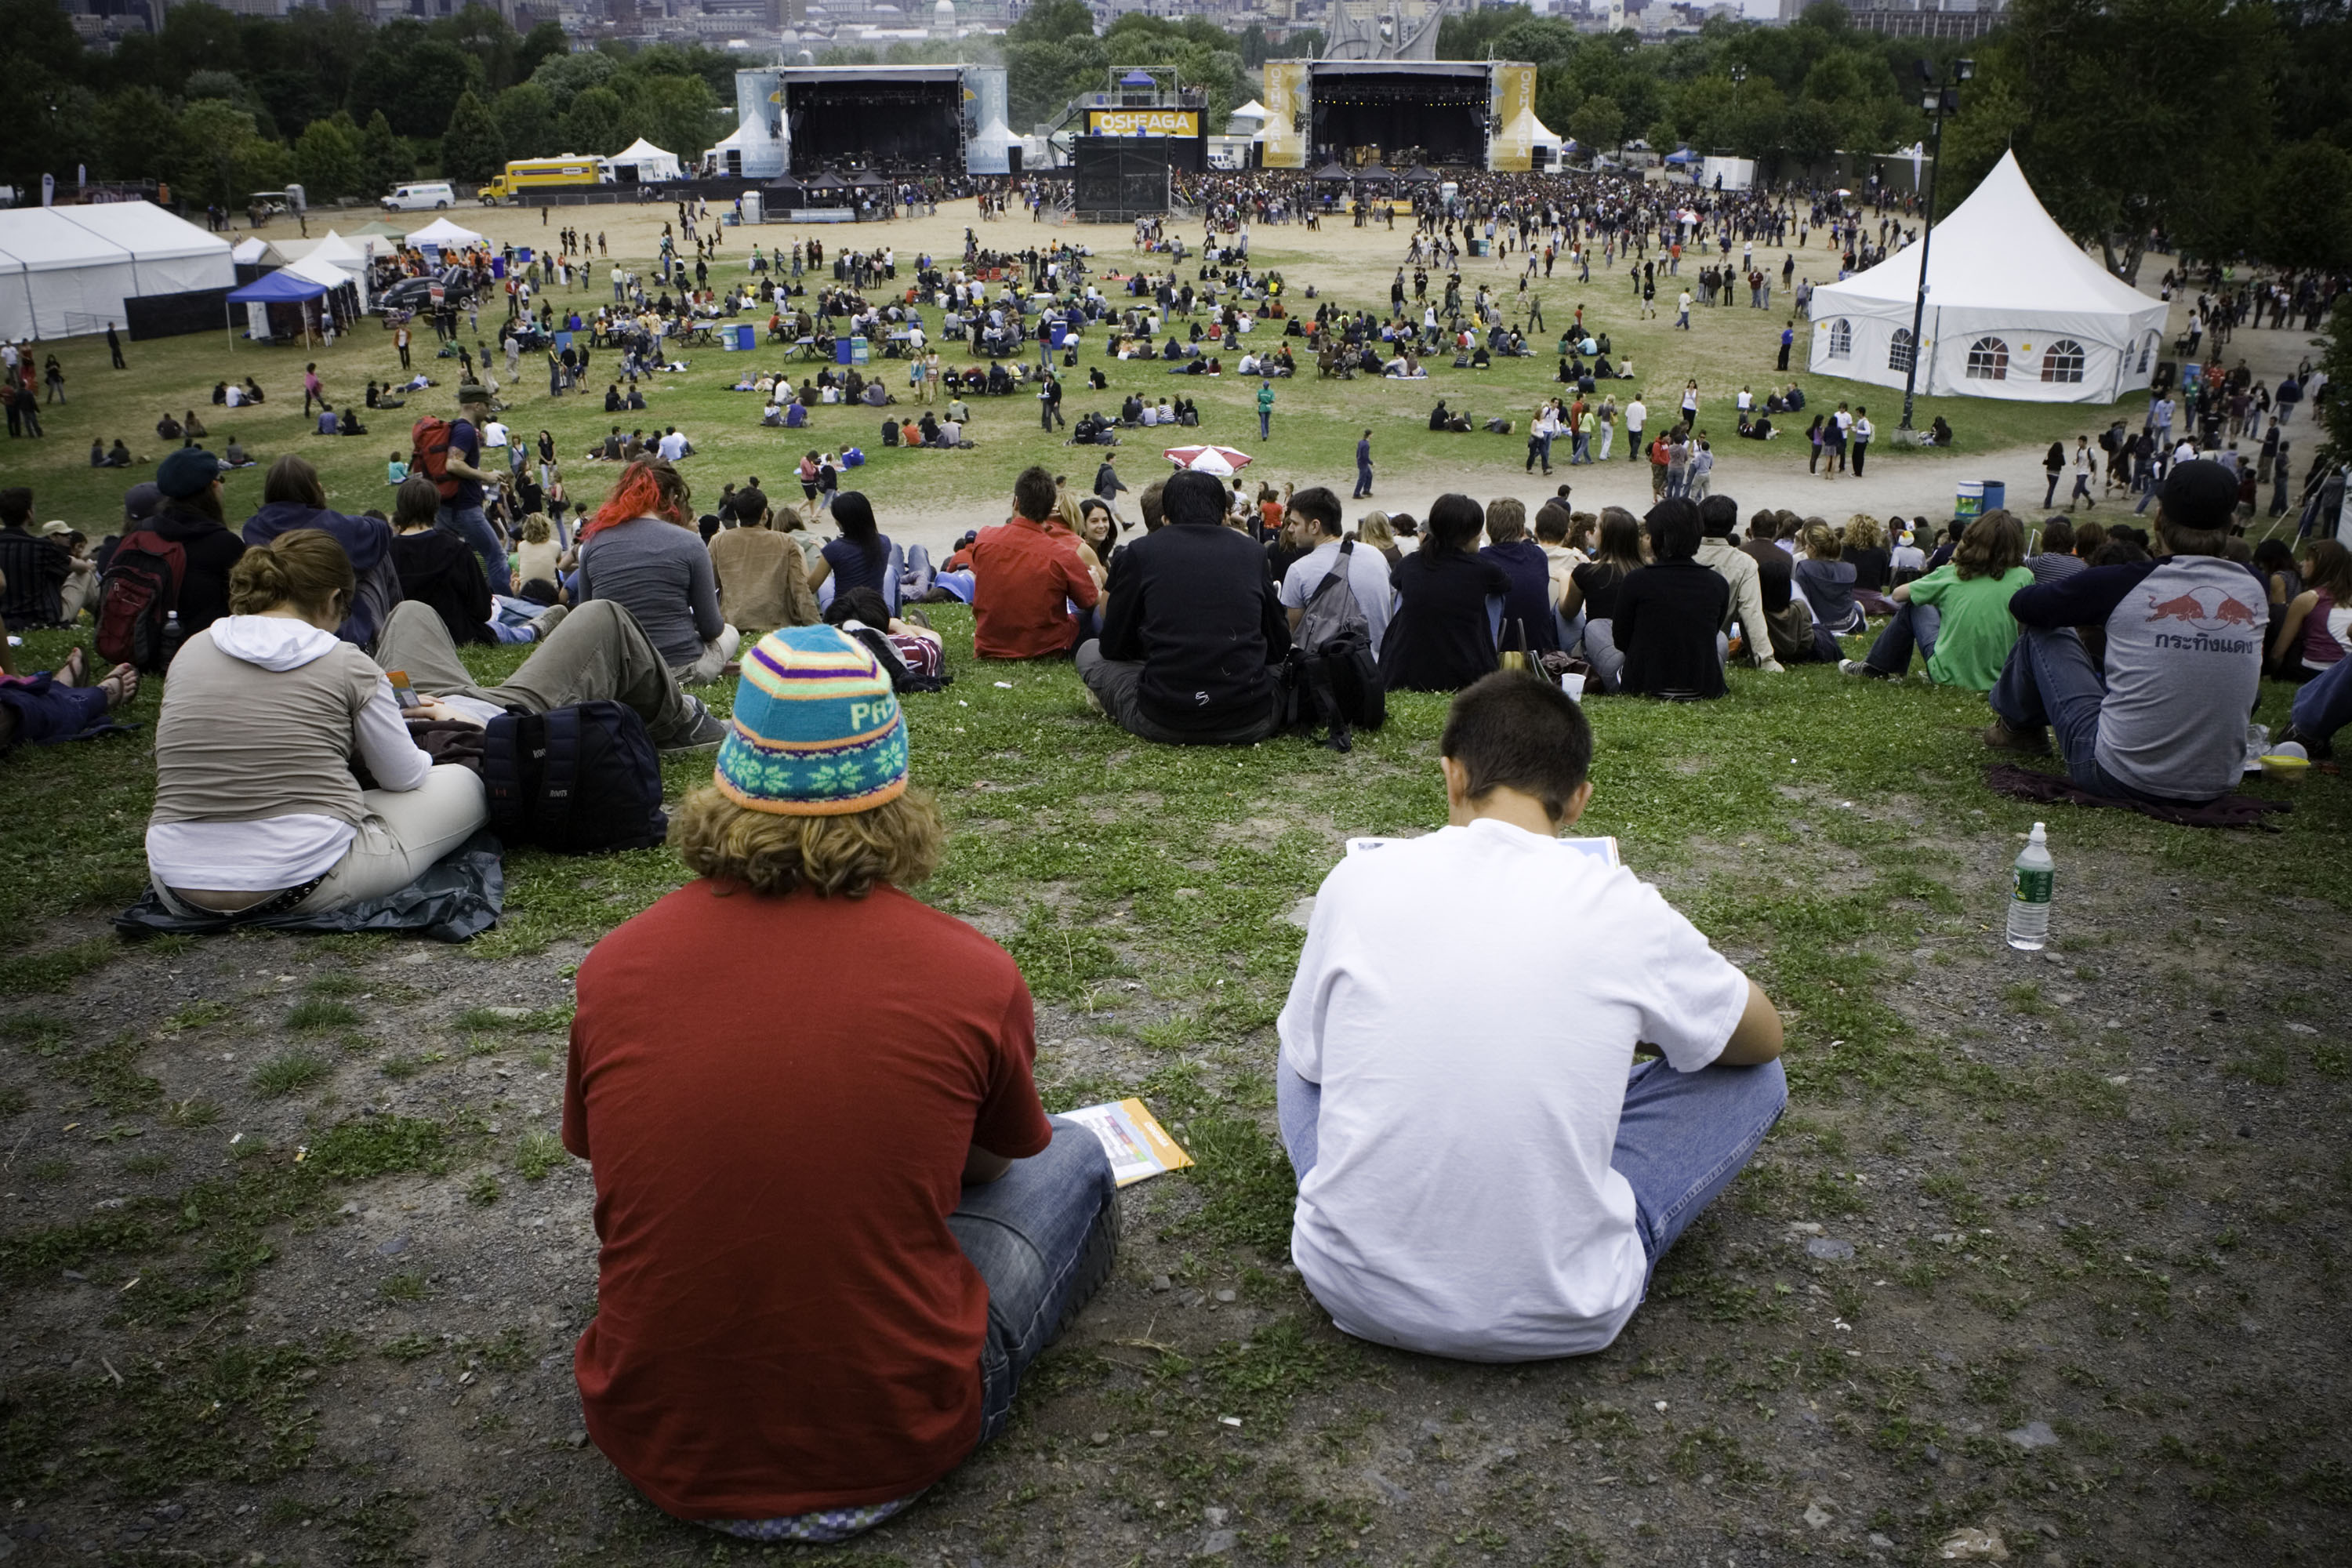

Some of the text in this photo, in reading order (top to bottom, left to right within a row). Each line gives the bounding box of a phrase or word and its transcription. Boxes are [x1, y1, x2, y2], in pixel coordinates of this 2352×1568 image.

[1100, 114, 1189, 129] OSHEAGA
[2154, 633, 2252, 654] กระทิงแดง
